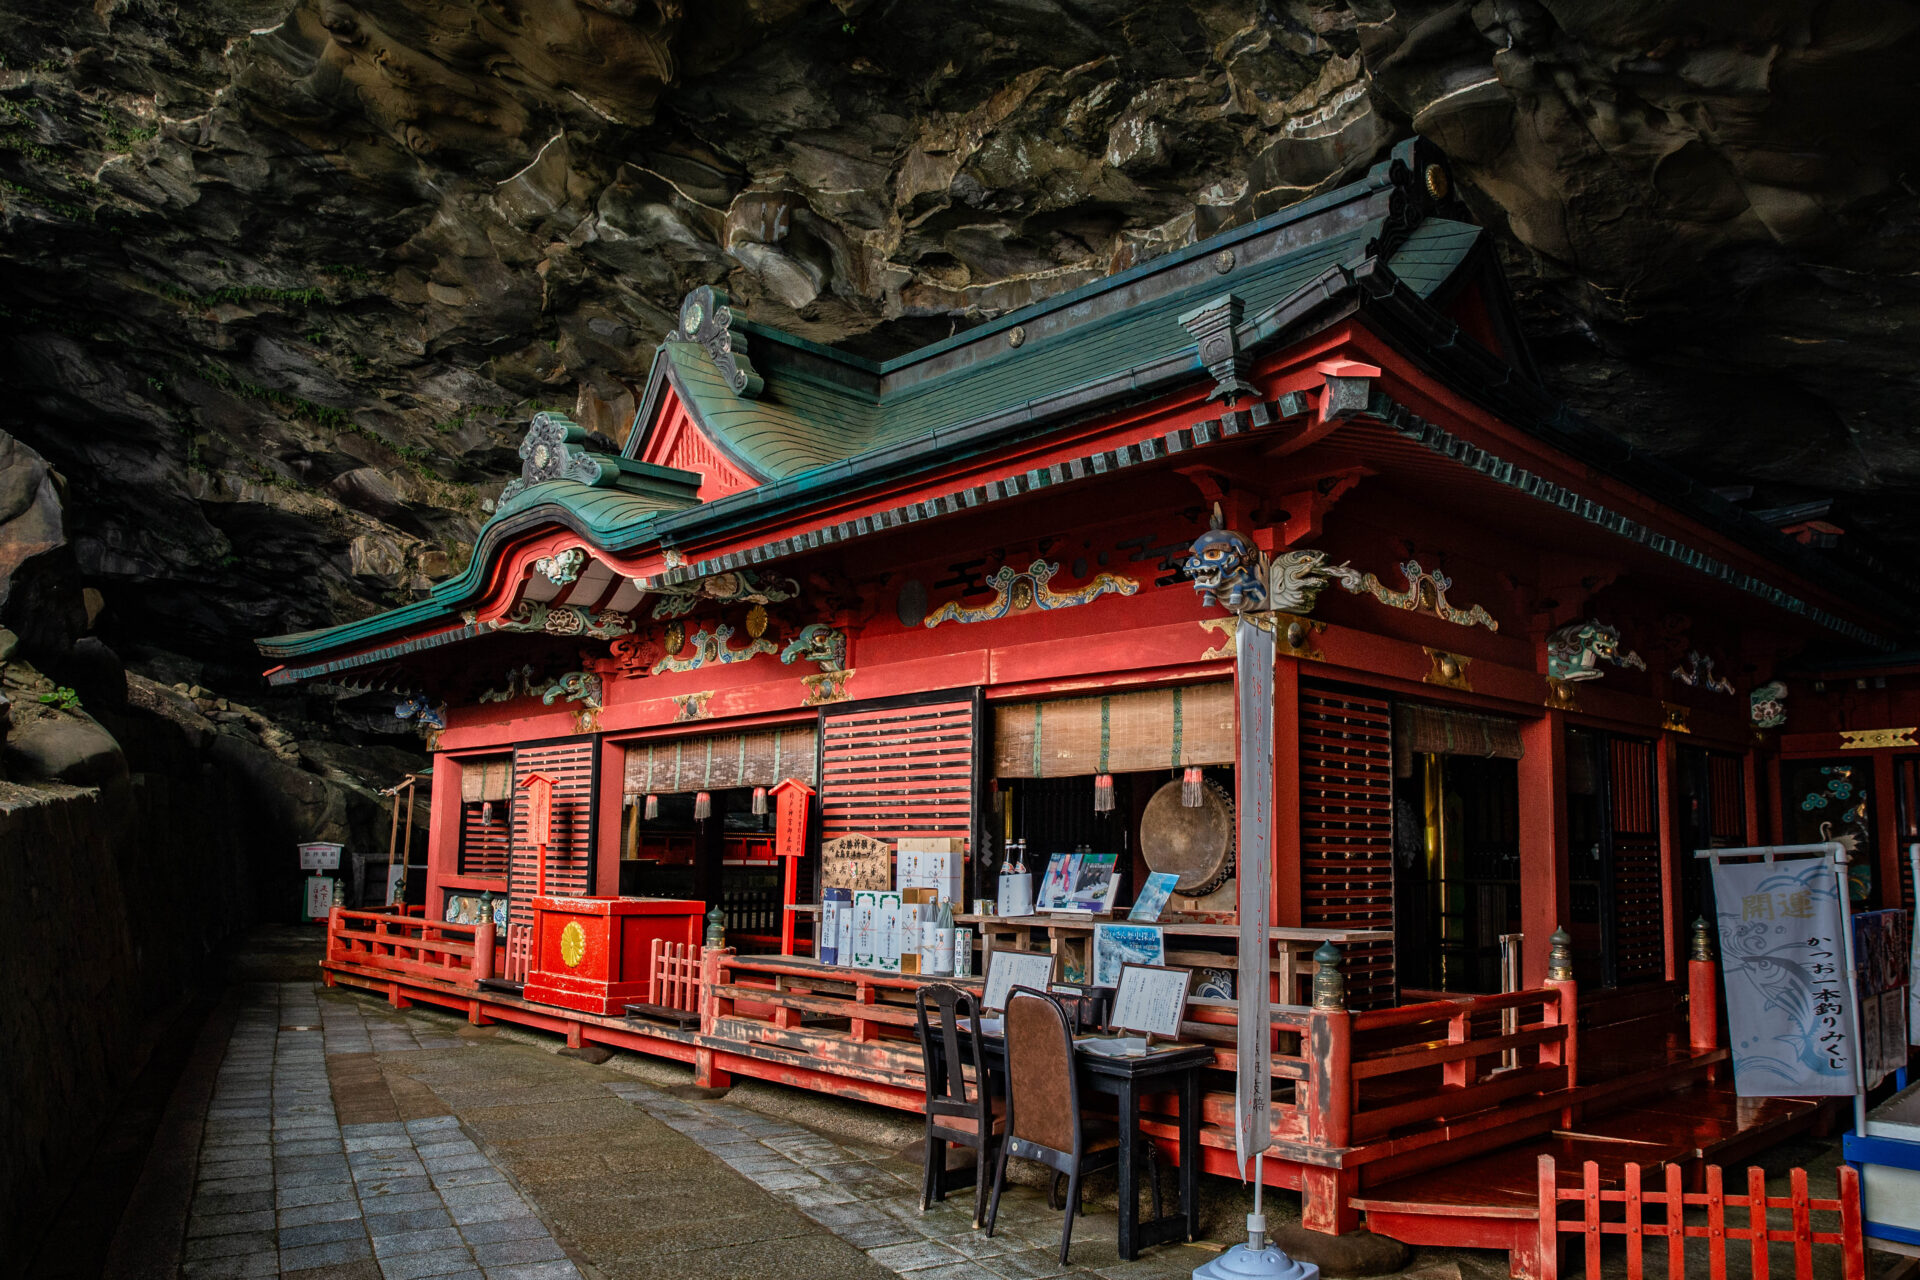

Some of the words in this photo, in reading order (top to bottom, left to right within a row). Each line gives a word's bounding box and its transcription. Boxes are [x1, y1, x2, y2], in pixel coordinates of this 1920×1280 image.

[1742, 890, 1816, 920] 開運
[1806, 936, 1848, 1070] かつお一本釣りみくじ
